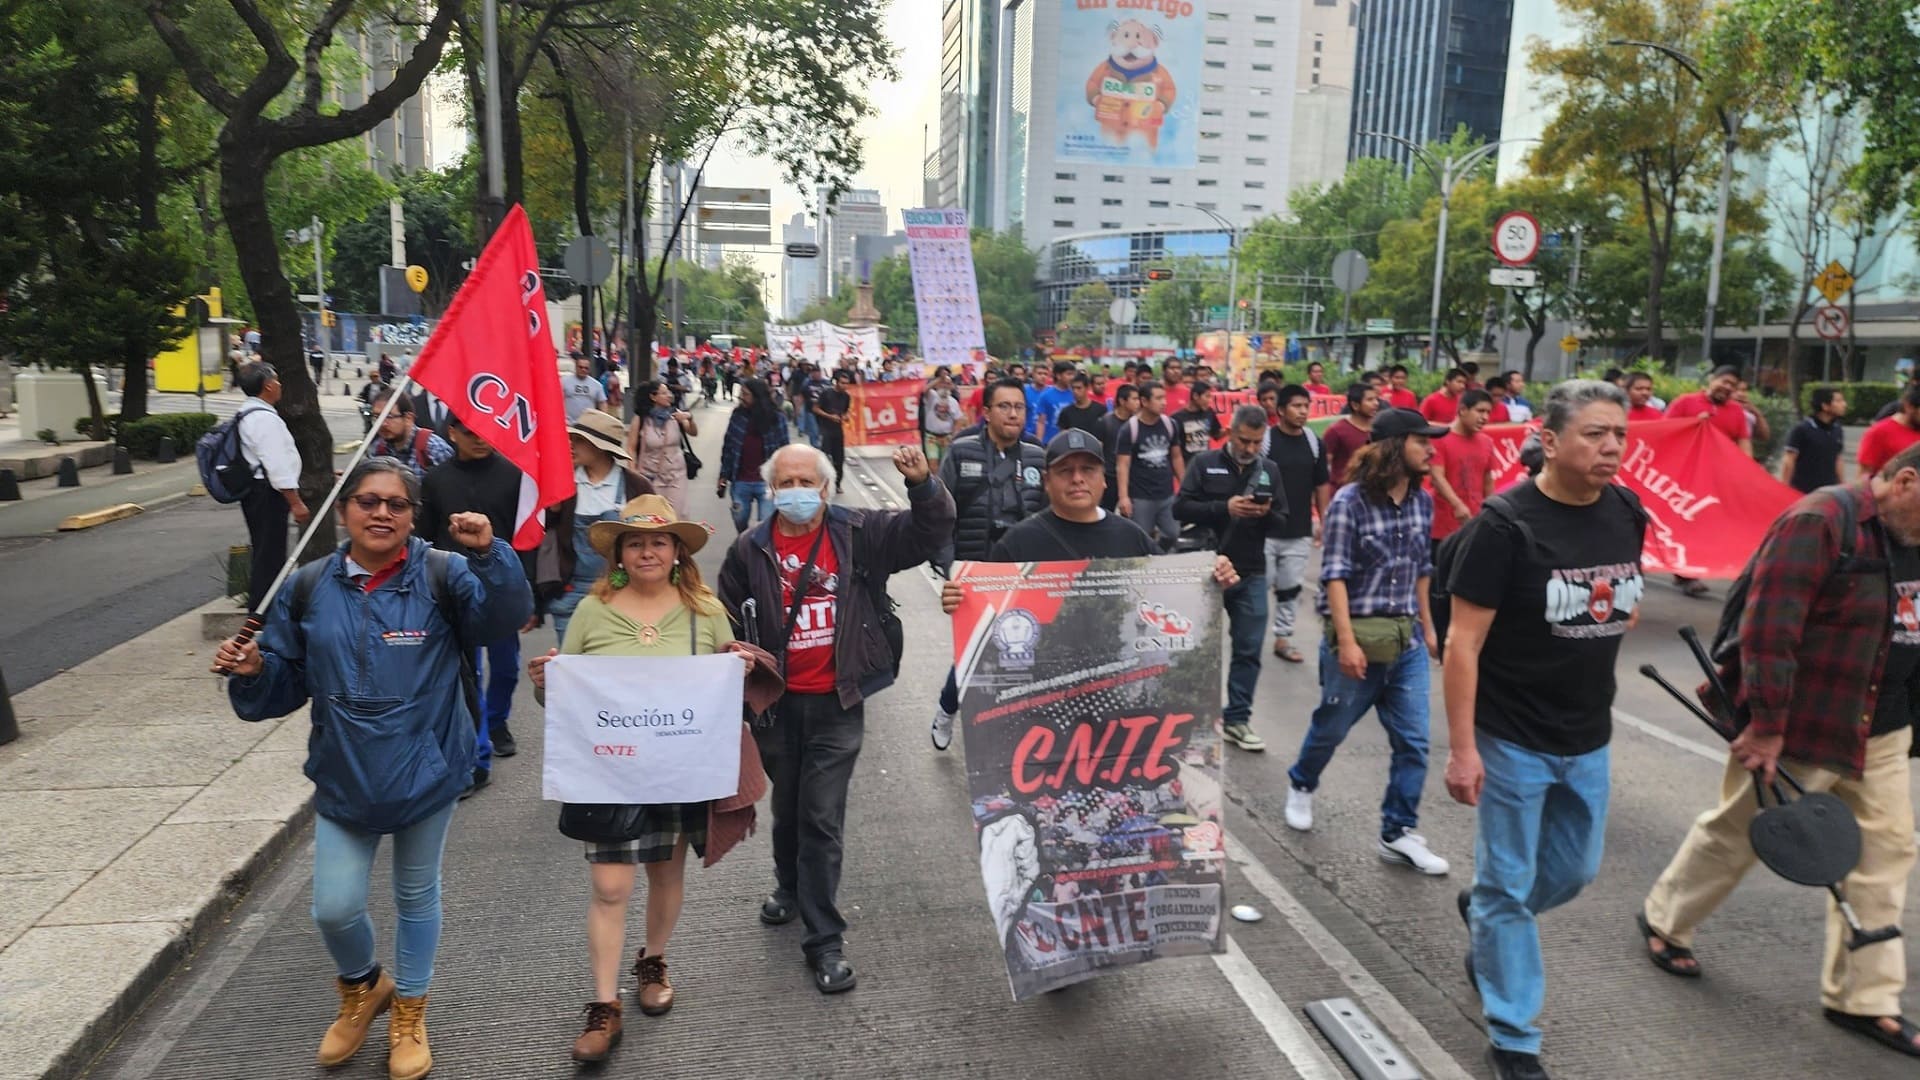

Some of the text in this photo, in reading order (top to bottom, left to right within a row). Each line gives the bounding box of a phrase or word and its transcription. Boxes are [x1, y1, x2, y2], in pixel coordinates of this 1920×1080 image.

[1507, 224, 1527, 240] 50
[863, 402, 898, 429] La
[1622, 438, 1721, 521] Rural
[597, 708, 694, 728] Sección 9
[593, 745, 638, 757] CNTE
[1011, 713, 1195, 794] C.N.T.E
[1055, 890, 1149, 951] CNTE
